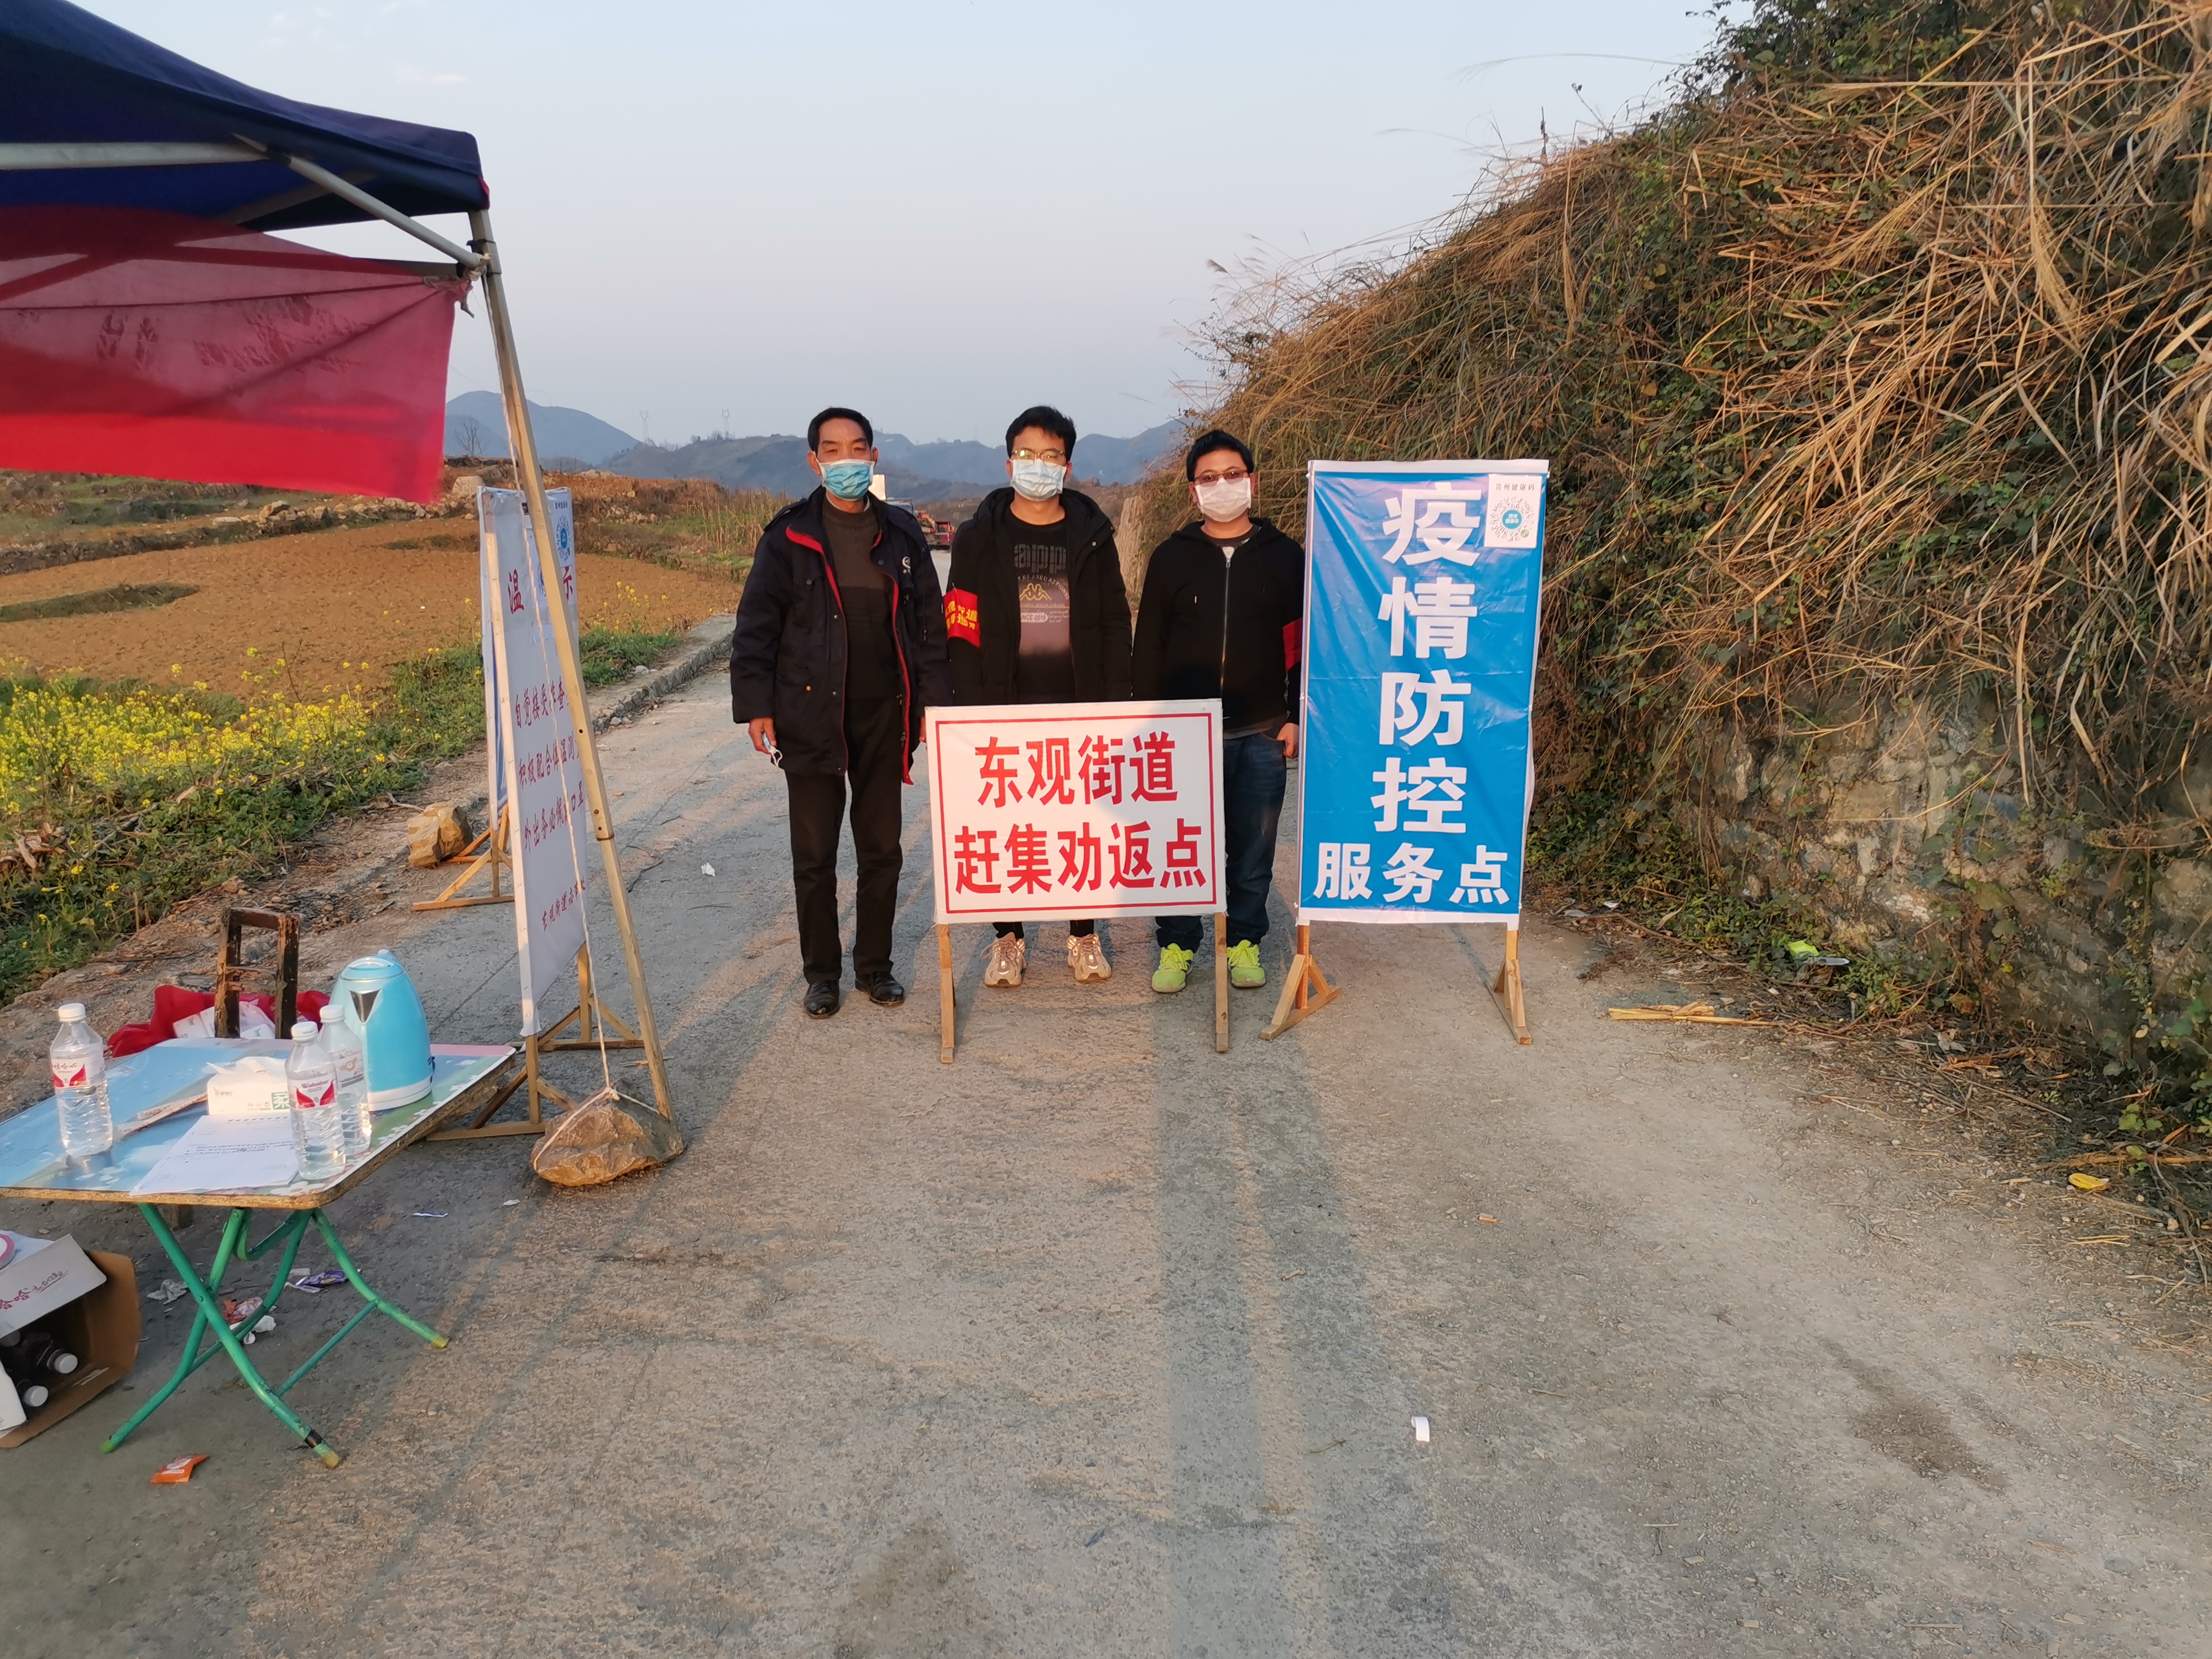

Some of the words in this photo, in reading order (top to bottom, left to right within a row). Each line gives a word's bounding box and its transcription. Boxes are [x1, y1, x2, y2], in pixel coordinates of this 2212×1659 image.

[1014, 544, 1067, 574] app
[1370, 482, 1482, 833] 疫情防控
[519, 730, 580, 790] 积极配合体温测
[974, 731, 1178, 808] 东观街道
[954, 817, 1207, 895] 赶集劝返点
[1313, 842, 1510, 904] 服务点
